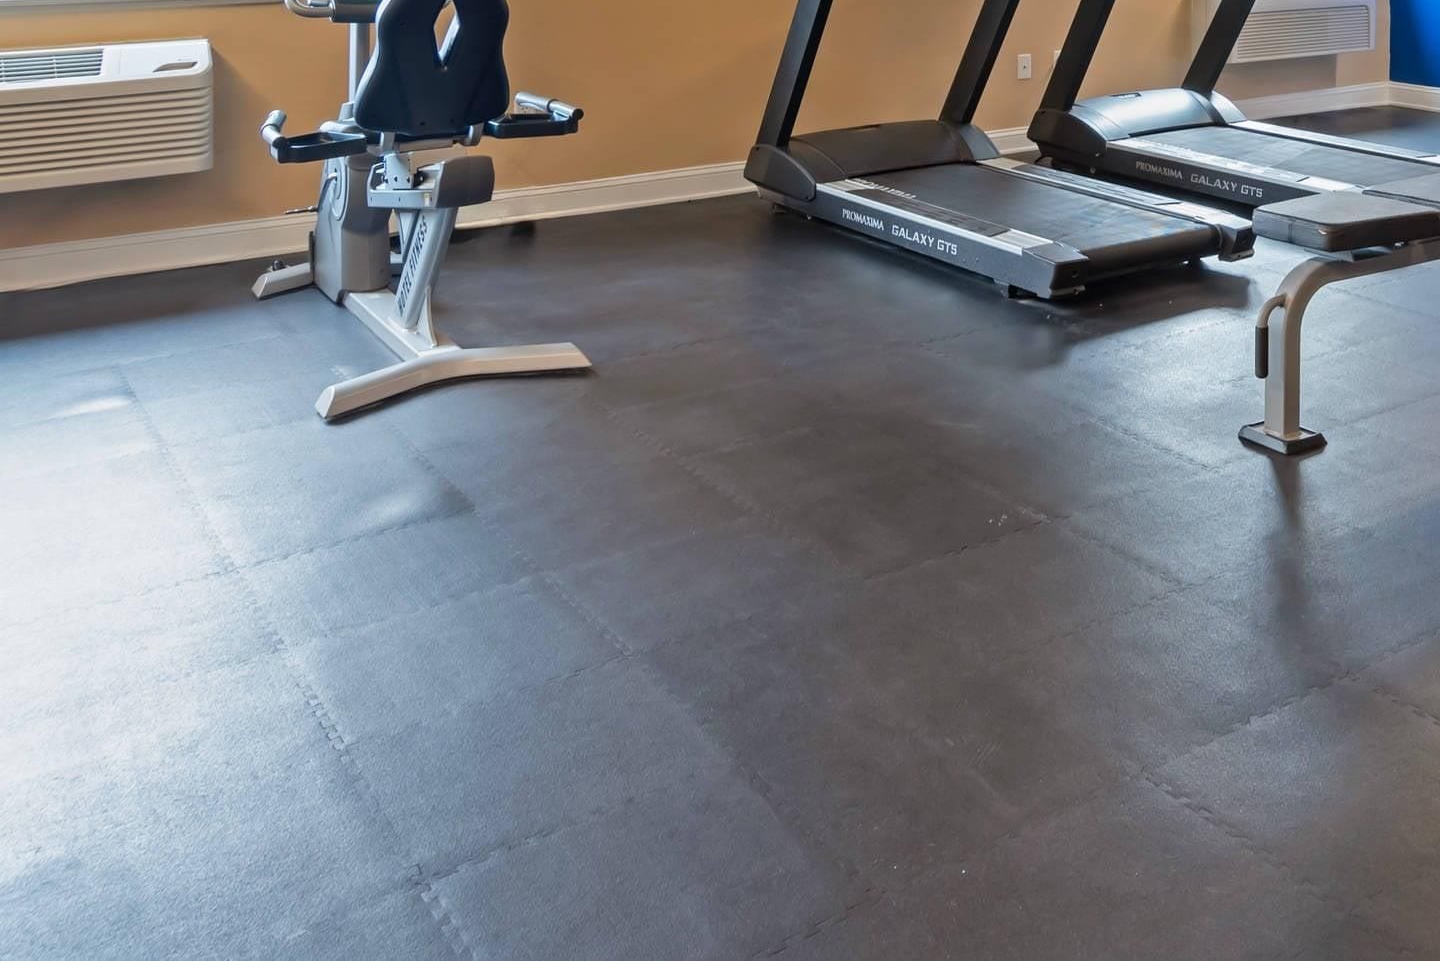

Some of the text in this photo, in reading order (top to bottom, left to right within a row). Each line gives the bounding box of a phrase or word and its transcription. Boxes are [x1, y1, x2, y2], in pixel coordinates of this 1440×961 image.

[1135, 160, 1183, 180] PROMAXIMA
[1190, 173, 1238, 192] GALAXY
[842, 208, 885, 231] PROMAXIMA
[891, 224, 935, 247] GALAXY
[397, 218, 428, 317] HOTEL FITNESS
